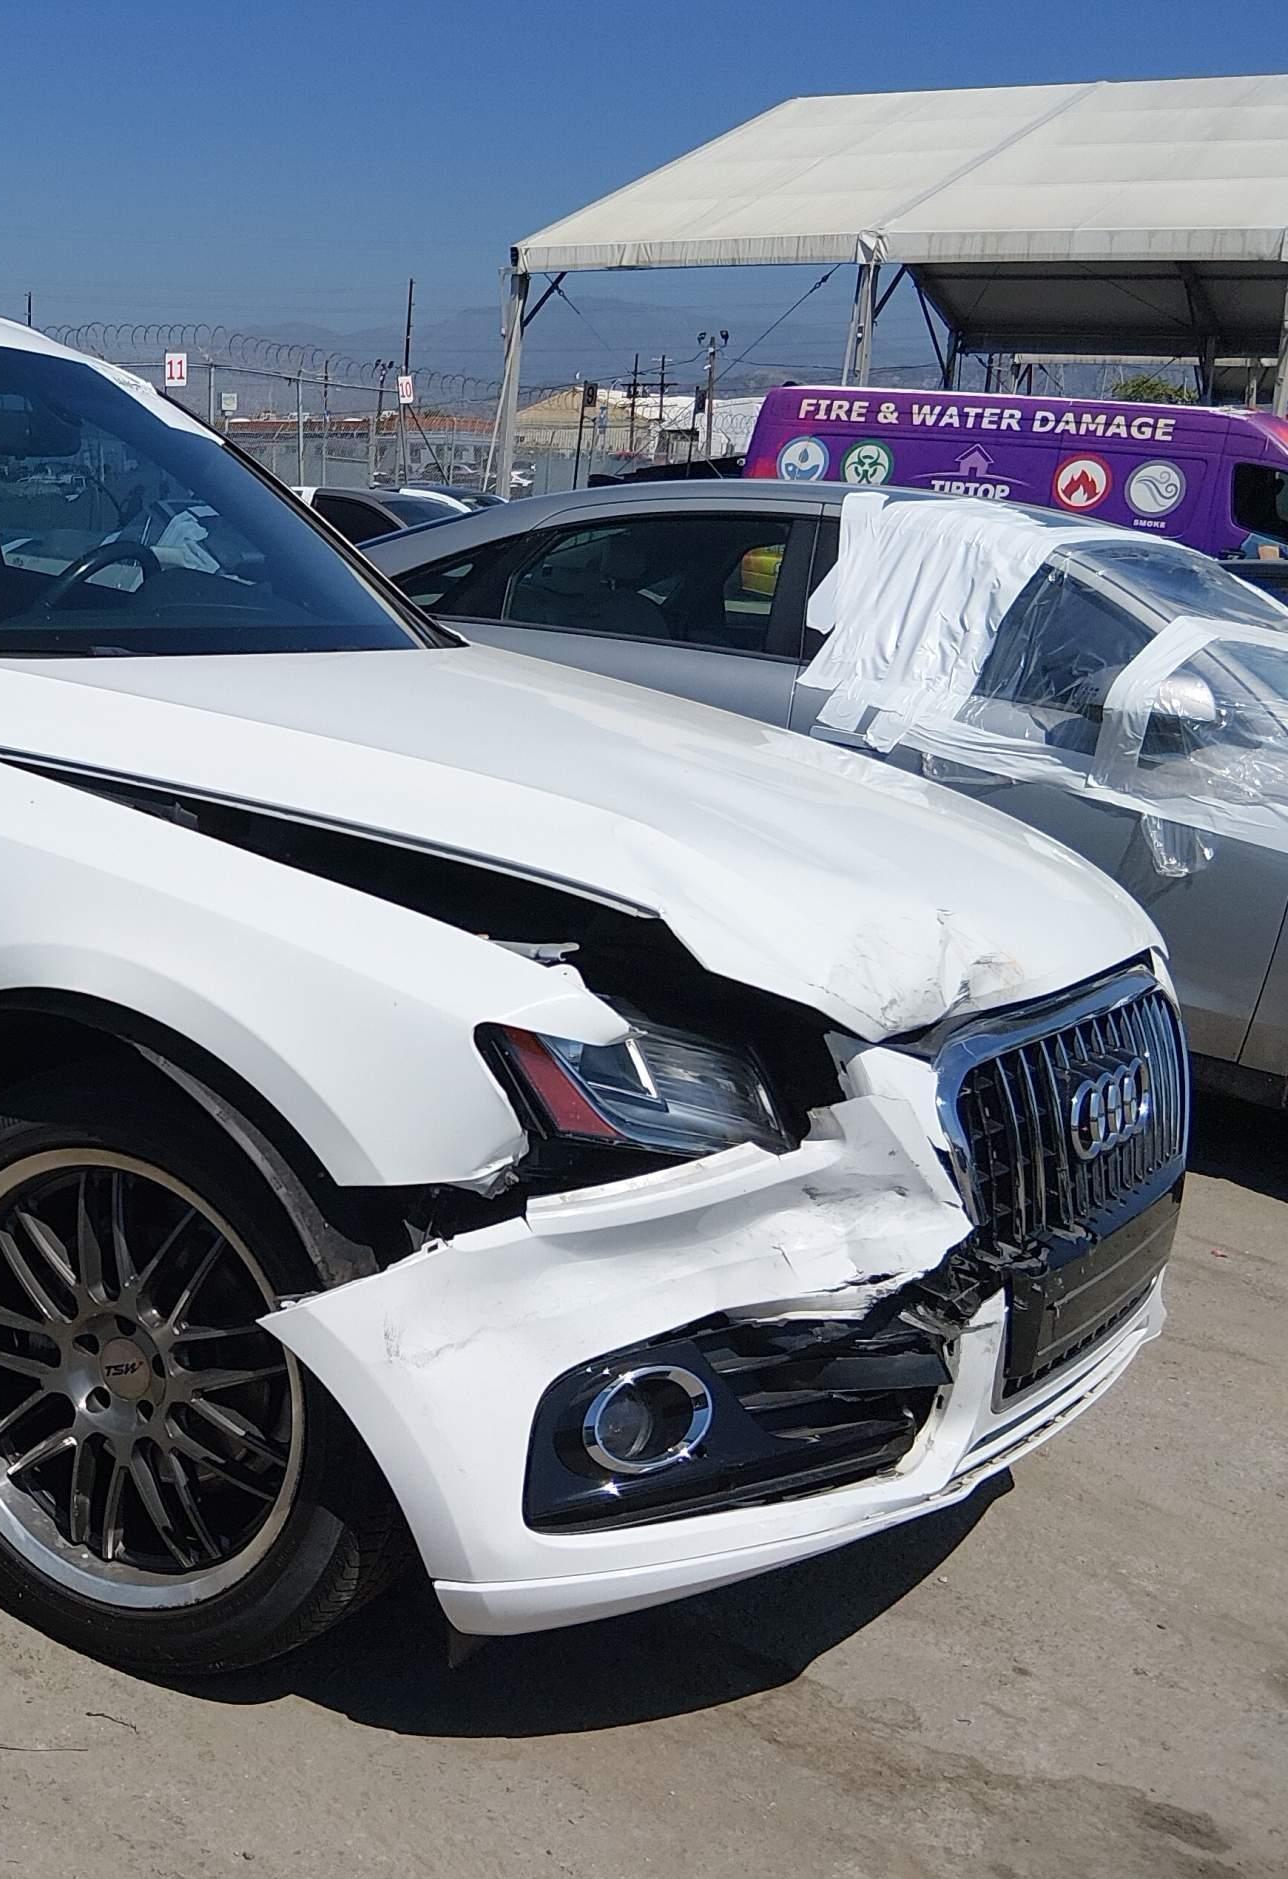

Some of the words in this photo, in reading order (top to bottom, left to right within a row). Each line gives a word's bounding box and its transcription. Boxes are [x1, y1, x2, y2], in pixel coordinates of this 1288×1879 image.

[167, 360, 185, 380] 11
[399, 382, 412, 398] 10
[586, 385, 595, 405] 9
[798, 399, 869, 423] FIRE
[877, 401, 899, 425] &
[912, 404, 1022, 433] WATER
[1032, 410, 1176, 442] DAMAGE
[930, 479, 1010, 500] TIPTOP
[1133, 518, 1166, 529] SMOKE
[104, 1360, 144, 1377] TSW
